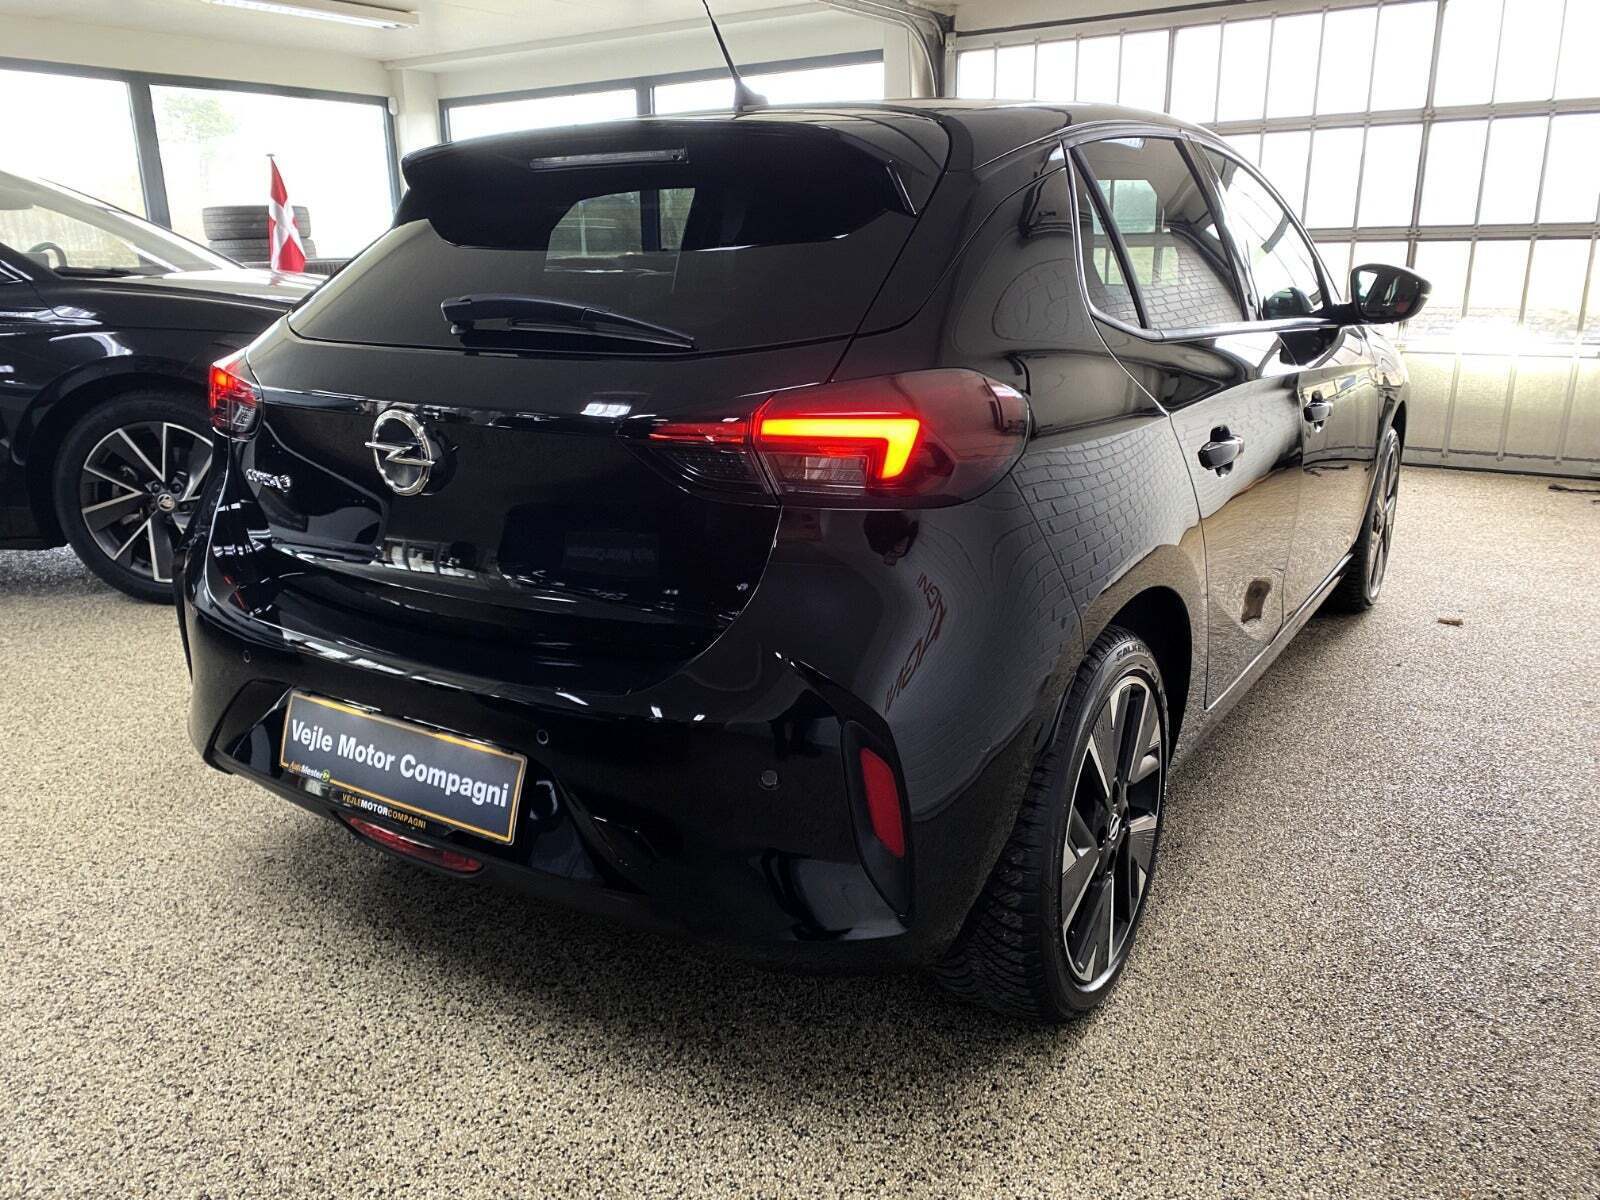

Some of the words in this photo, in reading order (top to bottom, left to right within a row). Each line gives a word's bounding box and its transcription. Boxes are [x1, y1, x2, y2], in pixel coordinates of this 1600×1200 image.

[292, 719, 333, 752] Vejle
[337, 734, 396, 772] Motor
[399, 754, 509, 808] Compagni
